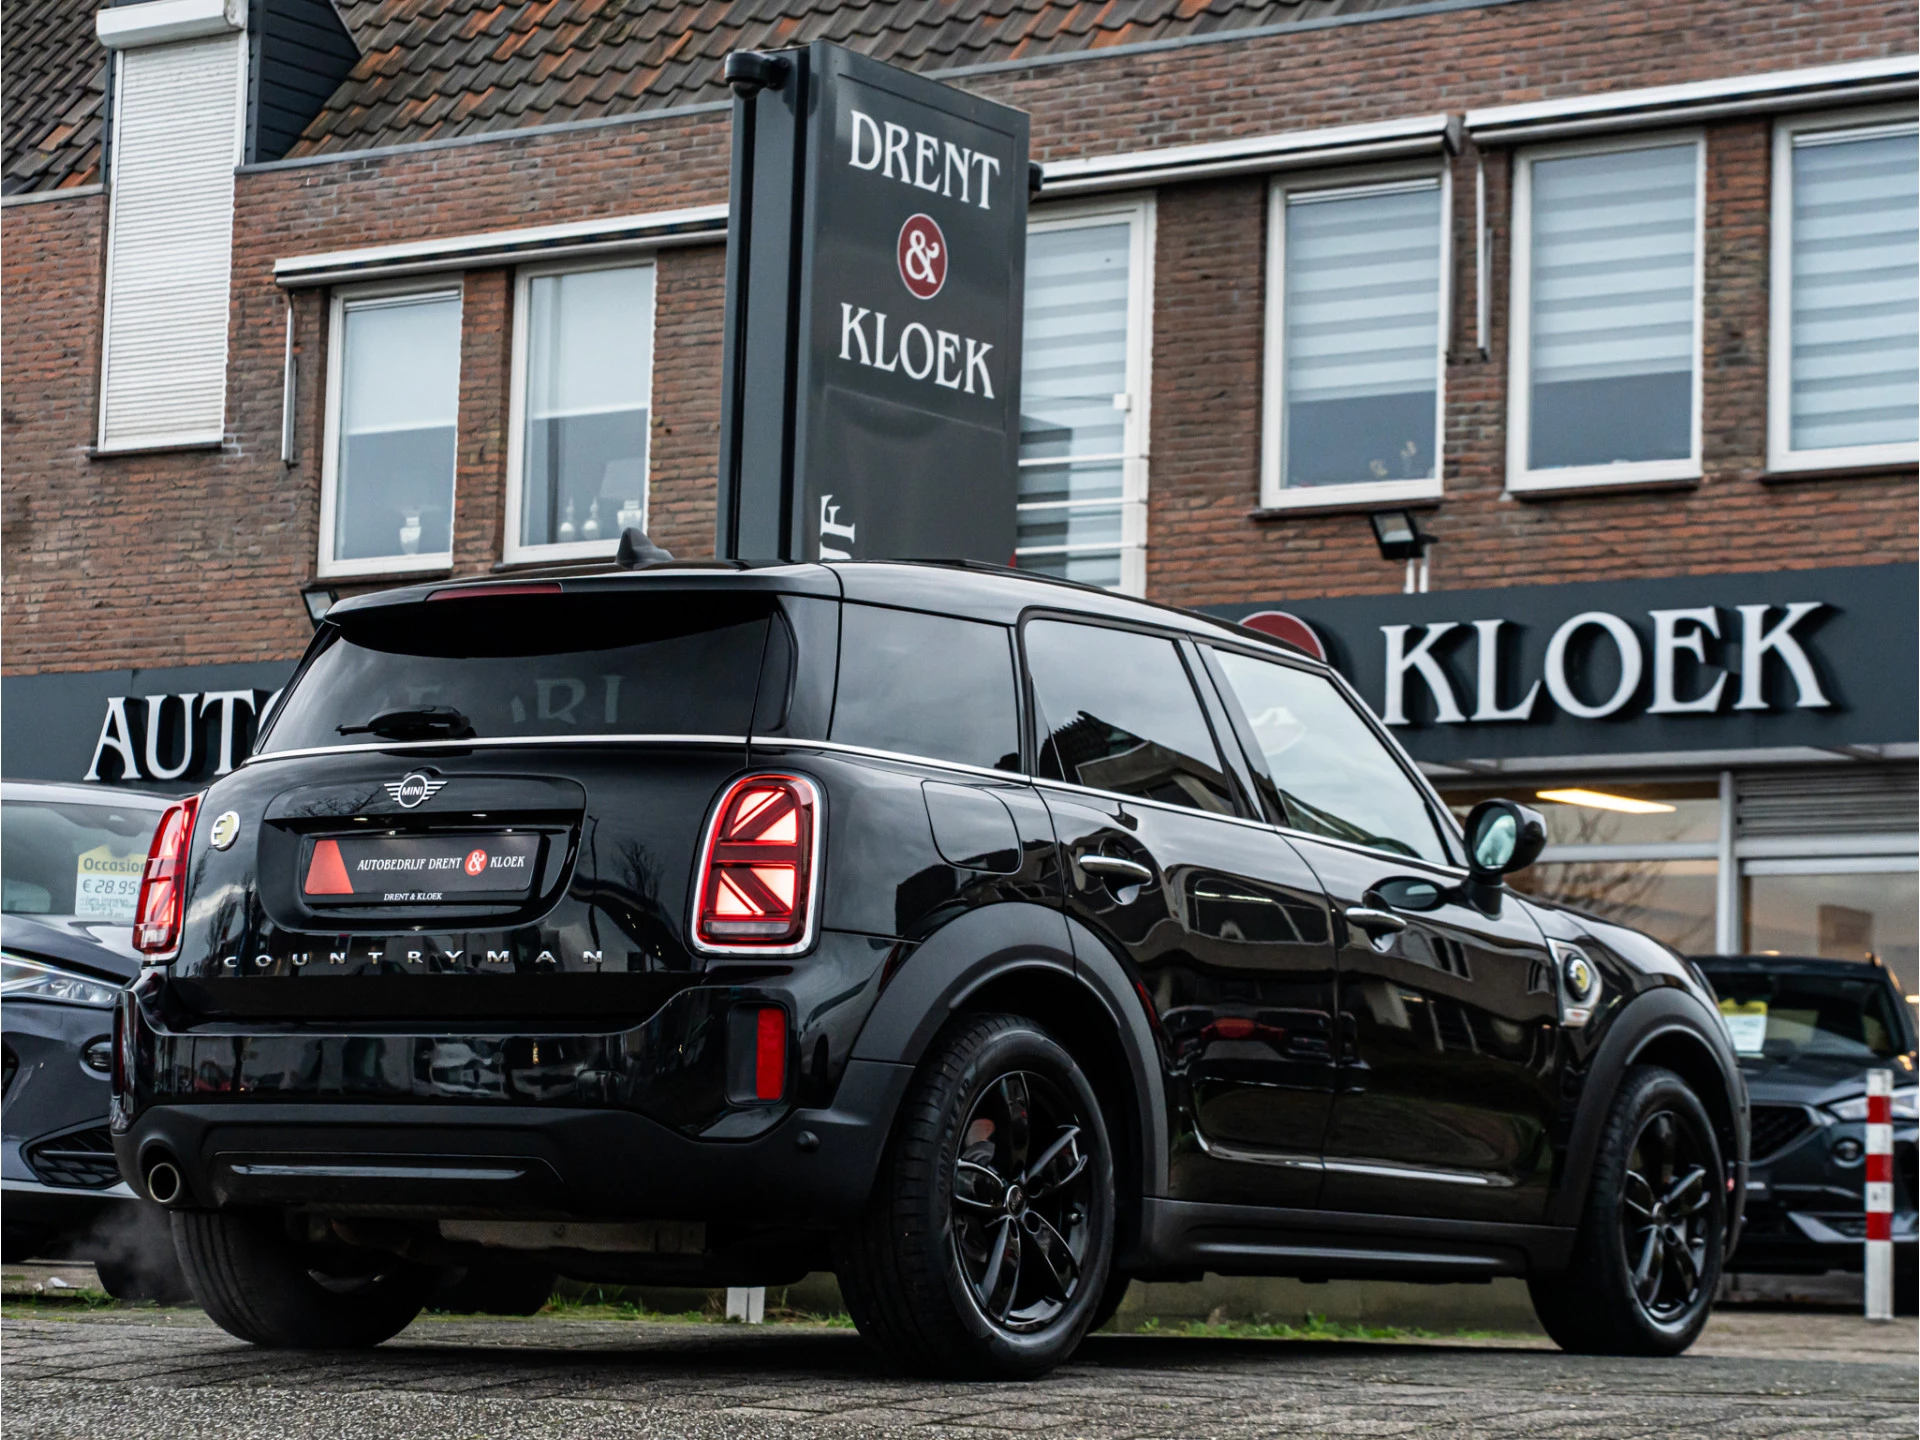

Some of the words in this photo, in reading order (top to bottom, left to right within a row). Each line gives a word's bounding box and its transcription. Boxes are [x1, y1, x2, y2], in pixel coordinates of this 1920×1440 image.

[847, 109, 1000, 211] DRENT
[904, 229, 940, 286] &
[838, 302, 995, 400] KLOEK
[1379, 601, 1831, 726] KLOEK
[83, 687, 284, 781] AUT
[401, 785, 425, 796] MINI
[357, 858, 427, 871] AUTOBEDRIJF
[428, 857, 462, 870] DRENT
[468, 852, 486, 872] &
[490, 855, 526, 868] KLOEK
[95, 879, 142, 896] 28.95
[384, 893, 409, 901] DRENT
[417, 892, 443, 901] KLOEK
[223, 950, 604, 968] COUNTRYMAN
